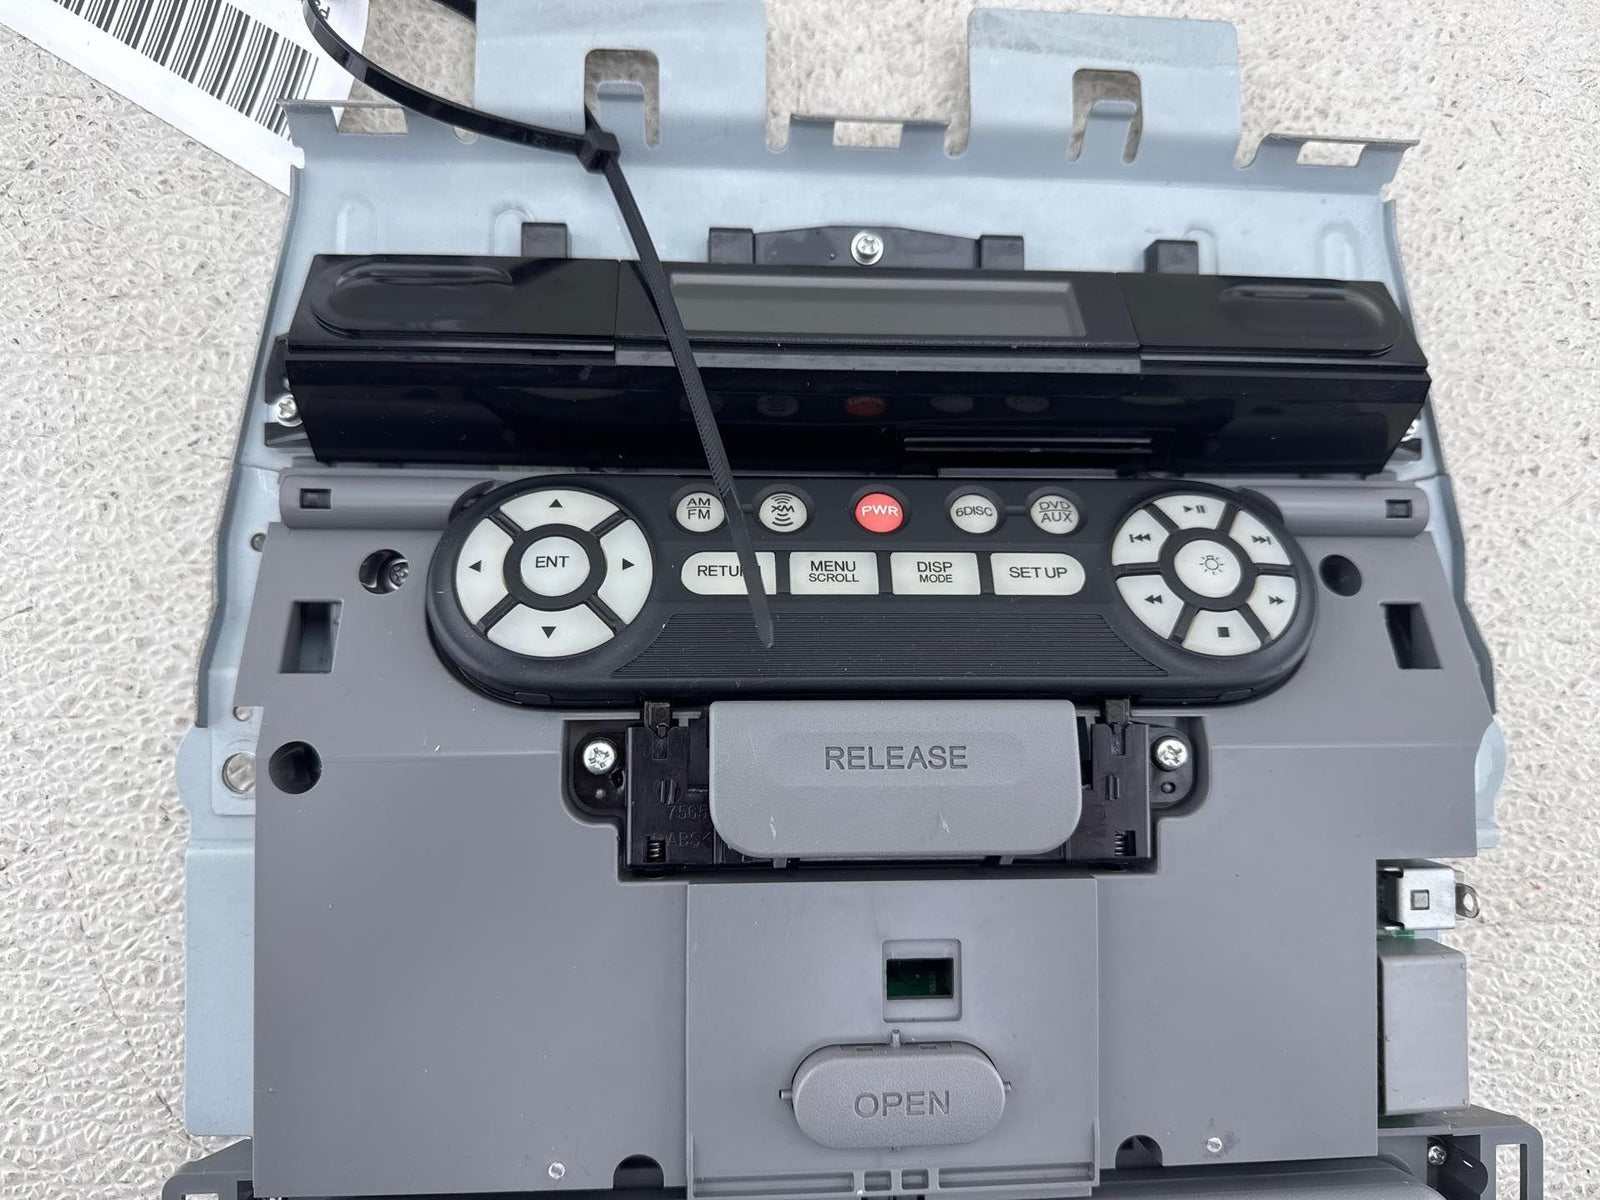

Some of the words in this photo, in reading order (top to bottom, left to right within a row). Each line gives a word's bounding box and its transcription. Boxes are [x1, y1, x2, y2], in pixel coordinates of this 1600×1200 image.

[686, 497, 711, 507] AM
[1039, 500, 1071, 511] DVD
[687, 508, 711, 520] FM
[861, 505, 899, 517] PWR
[955, 506, 993, 517] 6DISC
[1040, 512, 1073, 524] AUX
[535, 555, 570, 568] ENT
[810, 560, 856, 572] MENU
[916, 561, 953, 573] DISP
[697, 565, 761, 577] RETU
[808, 573, 859, 583] SCROLL
[919, 574, 953, 583] MODE
[825, 746, 968, 770] RELEASE
[854, 1090, 950, 1118] OPEN
